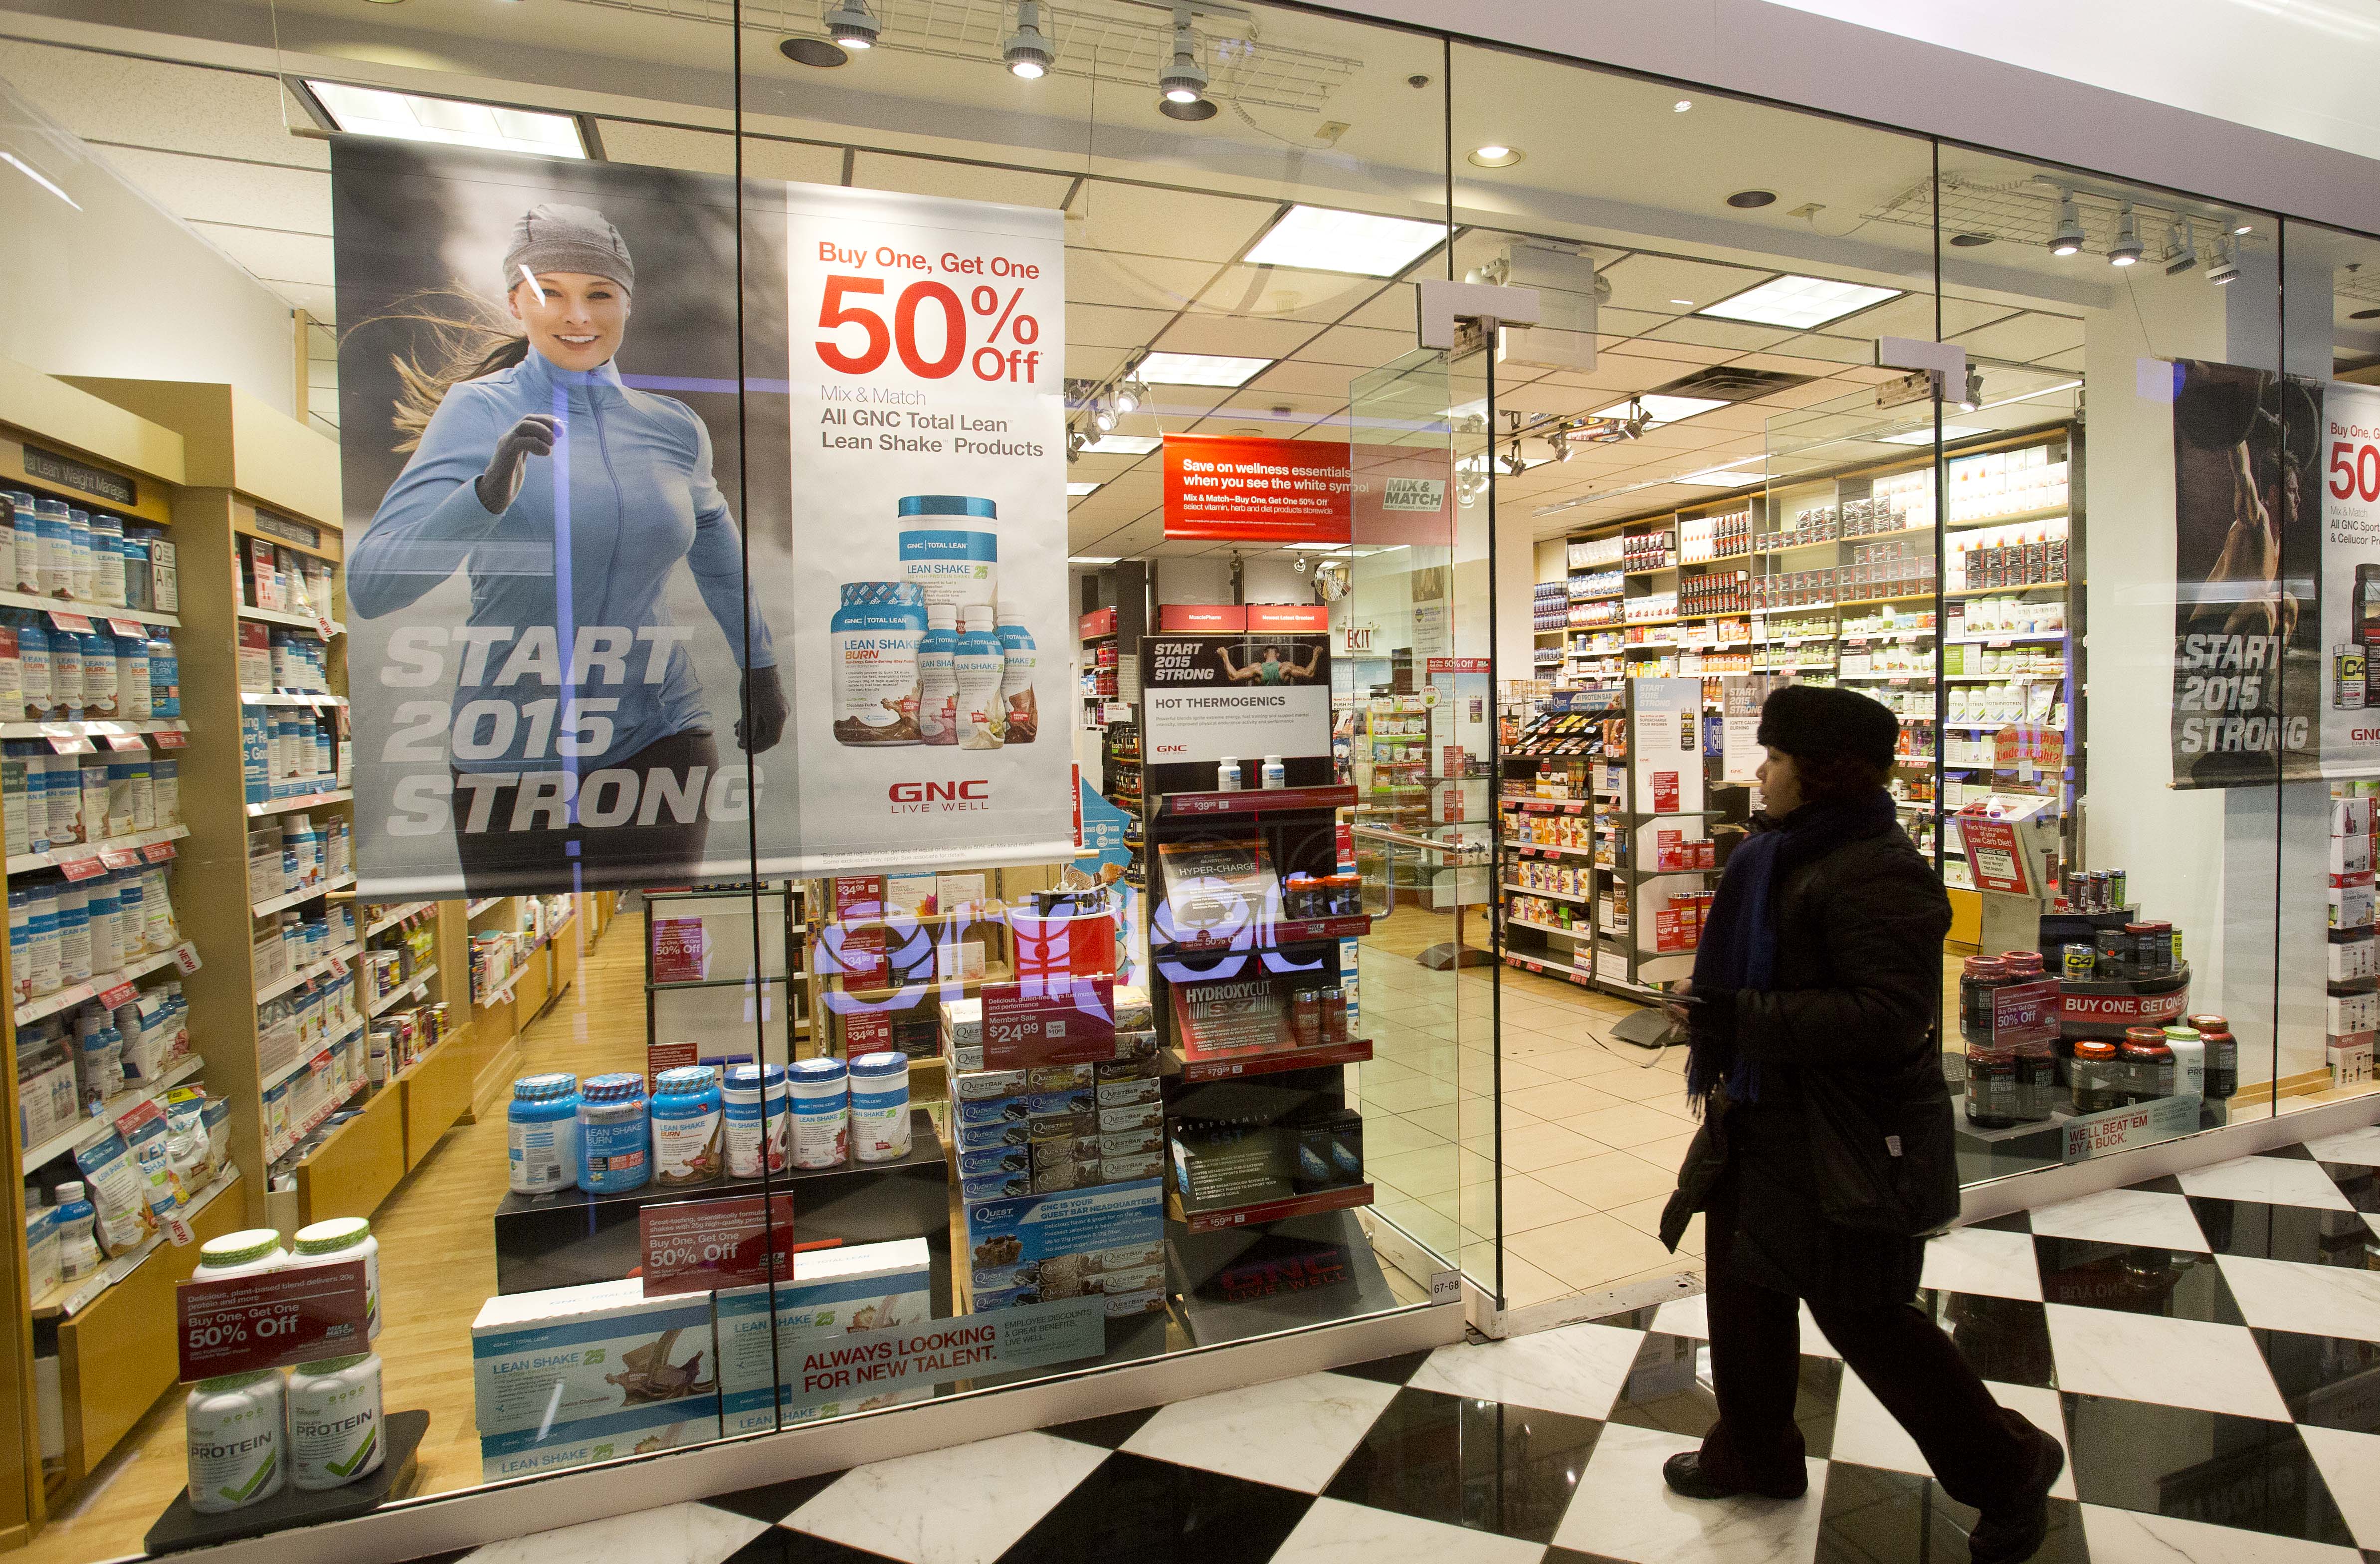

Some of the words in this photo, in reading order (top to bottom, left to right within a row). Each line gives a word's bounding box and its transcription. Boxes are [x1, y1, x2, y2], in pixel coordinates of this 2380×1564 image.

[819, 241, 867, 268] Buy
[876, 247, 932, 274] One,
[941, 253, 984, 275] Get
[991, 257, 1039, 279] One
[815, 274, 1039, 379] 50%
[972, 347, 1039, 383] Off
[821, 386, 851, 402] Mix
[856, 388, 868, 402] &
[873, 388, 926, 405] Match
[821, 408, 846, 425] All
[853, 410, 900, 427] GNC
[907, 412, 954, 429] Total
[961, 415, 1007, 432] Lean
[2330, 422, 2348, 438] Buy
[2351, 425, 2370, 440] One,
[822, 432, 872, 449] Lean
[879, 434, 942, 452] Shake
[955, 437, 1043, 457] Products
[1183, 459, 1214, 471] Save
[1217, 463, 1233, 473] on
[1235, 463, 1289, 475] wellness
[1292, 466, 1351, 478] essentials
[1184, 474, 1218, 486] when
[1221, 478, 1243, 489] you
[1246, 479, 1269, 488] see
[1271, 478, 1291, 489] the
[1294, 479, 1326, 490] white
[1388, 479, 1418, 492] MIX
[1420, 482, 1429, 492] &
[1385, 492, 1442, 505] MATCH
[2331, 519, 2339, 529] All
[2342, 520, 2358, 530] GNC
[2331, 533, 2336, 543] &
[2338, 534, 2368, 544] Cellucor
[934, 565, 971, 574] SHAKE
[974, 566, 988, 579] 25
[381, 626, 695, 688] START
[845, 650, 879, 660] BURN
[1154, 643, 1202, 654] START
[2183, 634, 2282, 669] START
[1154, 656, 1190, 667] 2015
[2344, 659, 2365, 676] C4
[1155, 668, 1214, 680] STRONG
[1729, 688, 1757, 696] START
[2181, 676, 2261, 711] 2015
[1156, 699, 1182, 708] HOT
[1186, 697, 1285, 708] THERMOGENICS
[381, 698, 619, 763] 2015
[2181, 717, 2308, 753] STRONG
[1996, 748, 2060, 763] Underweight?
[387, 765, 765, 836] STRONG
[889, 780, 989, 802] GNC
[892, 804, 930, 813] LIVE
[942, 802, 989, 811] WELL
[1179, 862, 1257, 876] HYPER-CHARGE
[656, 946, 680, 956] 50%
[683, 944, 700, 954] Off
[177, 949, 195, 971] NEW!
[2068, 956, 2091, 966] C4
[1186, 980, 1271, 1003] HYDROXYCUT
[2065, 998, 2099, 1012] BUY
[2102, 1000, 2137, 1014] ONE,
[2141, 999, 2164, 1012] GET
[1998, 1014, 2018, 1027] 50%
[2021, 1010, 2035, 1022] Off
[2070, 1126, 2099, 1143] WE'LL
[2103, 1119, 2127, 1135] BEAT
[2070, 1143, 2083, 1155] BY
[2085, 1140, 2093, 1152] A
[170, 1220, 191, 1245] NEW!
[650, 1247, 697, 1267] 50%
[704, 1242, 738, 1261] Off
[1434, 1280, 1459, 1293] G7-G8
[189, 1318, 212, 1327] Buy
[216, 1312, 245, 1323] One,
[249, 1308, 272, 1318] Get
[274, 1304, 299, 1314] One
[1005, 1316, 1046, 1329] EMPLOYEE
[1048, 1309, 1092, 1322] DISCOUNTS
[189, 1324, 247, 1348] 50%
[256, 1315, 299, 1337] Off
[1012, 1327, 1037, 1336] GREAT
[803, 1344, 892, 1372] ALWAYS
[899, 1325, 995, 1355] LOOKING
[493, 1360, 530, 1374] LEAN
[534, 1353, 579, 1367] SHAKE
[804, 1371, 849, 1393] FOR
[857, 1361, 906, 1384] NEW
[914, 1344, 997, 1373] TALENT.
[191, 1431, 272, 1459] PROTEIN
